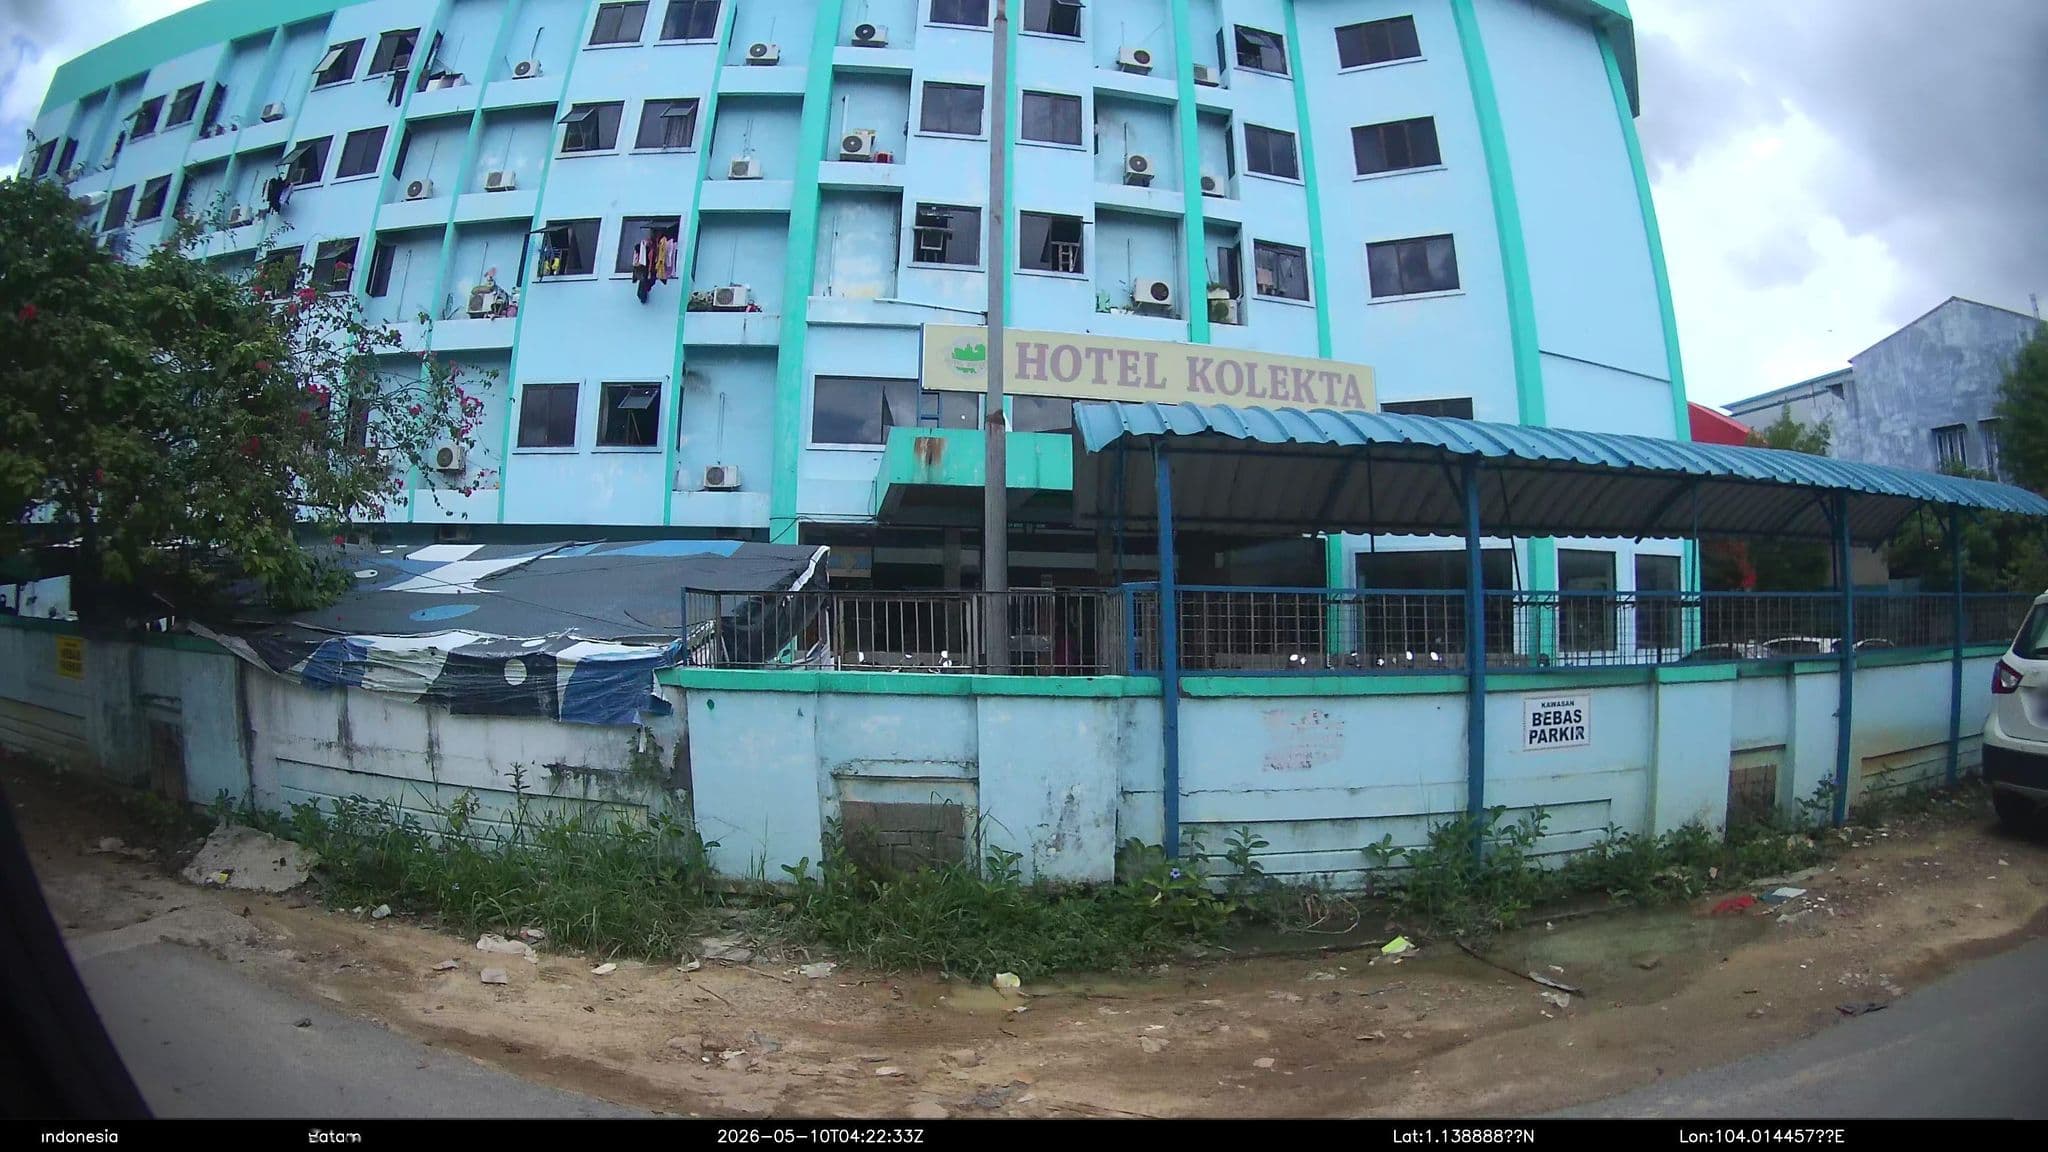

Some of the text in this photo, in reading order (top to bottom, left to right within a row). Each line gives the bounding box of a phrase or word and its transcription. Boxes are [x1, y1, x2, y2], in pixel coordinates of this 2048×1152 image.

[1015, 341, 1366, 409] HOTEL KOLEKTA
[1541, 700, 1575, 708] KAWASAN
[1532, 709, 1582, 727] BEBAS
[1529, 726, 1585, 744] PARKIR
